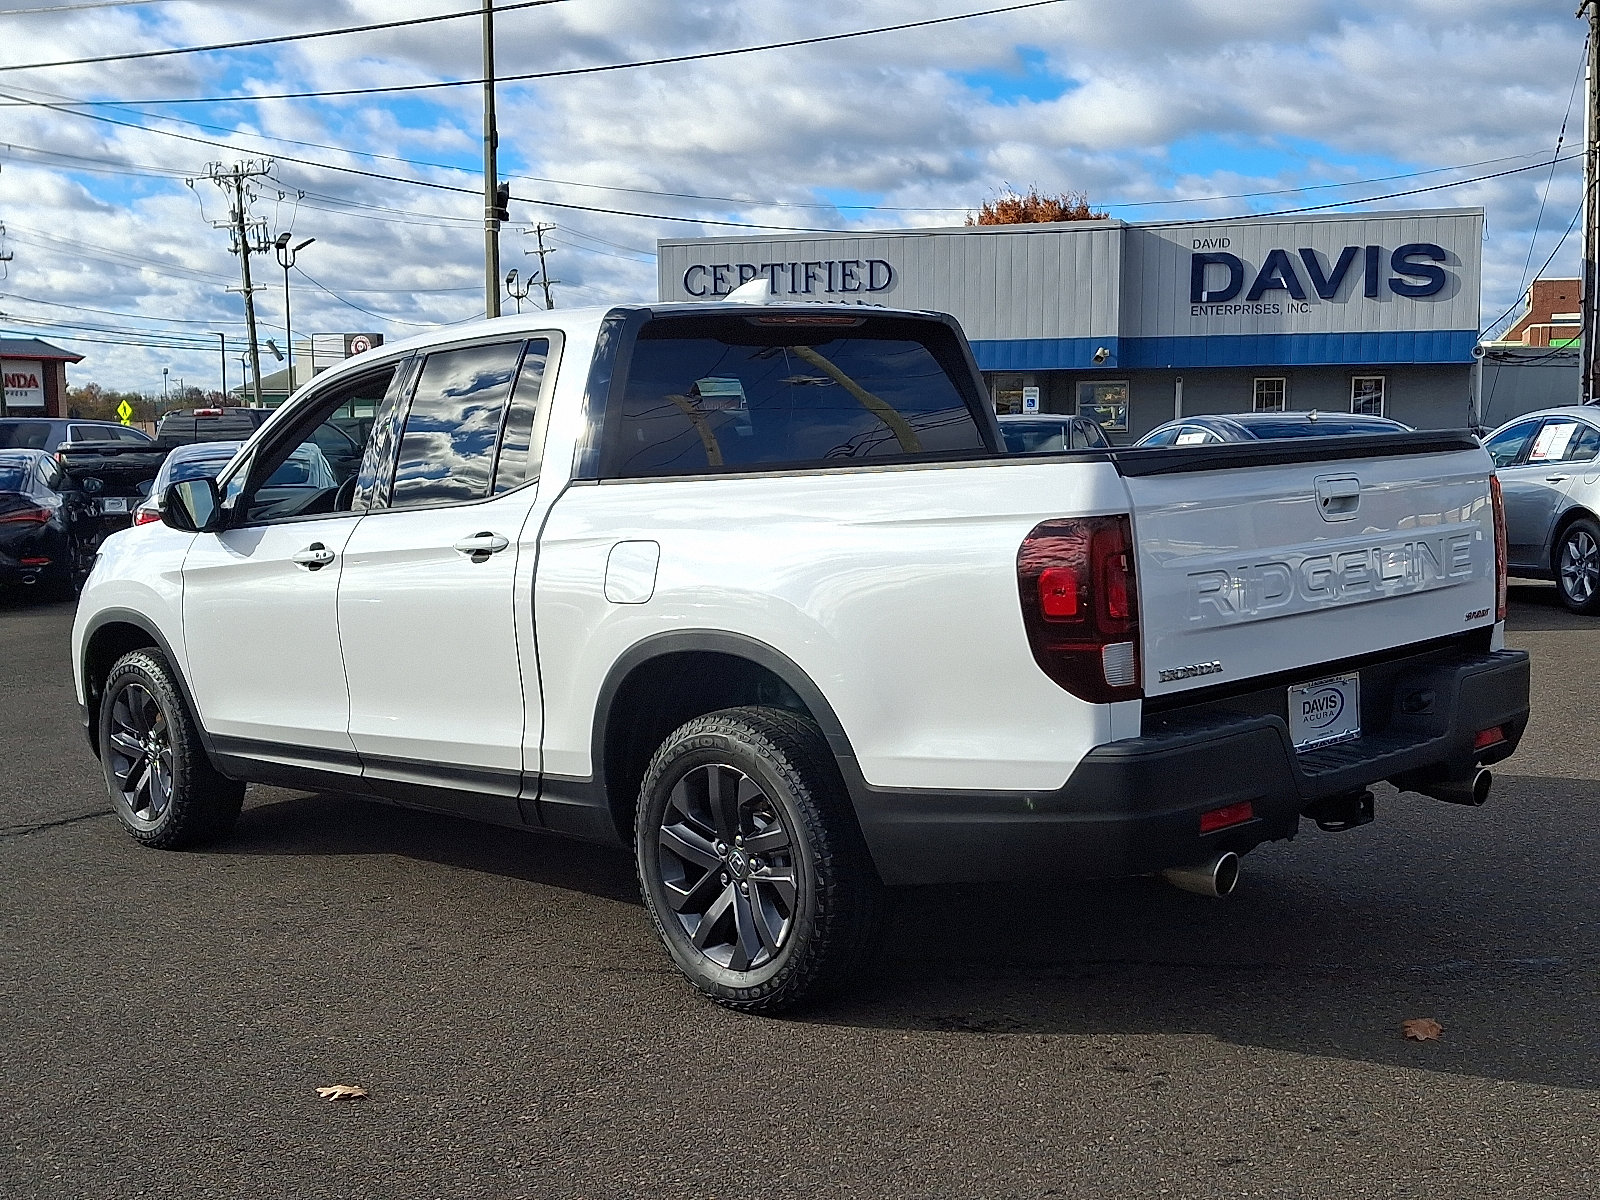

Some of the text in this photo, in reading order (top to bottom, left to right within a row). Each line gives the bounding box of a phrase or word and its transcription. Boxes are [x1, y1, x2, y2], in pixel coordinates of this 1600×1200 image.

[1192, 238, 1231, 250] DAVID
[683, 259, 893, 297] CERTIFIED
[1190, 243, 1447, 303] DAVIS
[1190, 302, 1313, 317] ENTERPRISES, INC.
[4, 373, 39, 388] NDA
[1187, 534, 1473, 621] RIDGELINE
[1158, 660, 1224, 683] HONDA
[1302, 694, 1338, 716] DAVIS
[1302, 710, 1335, 723] ACURA
